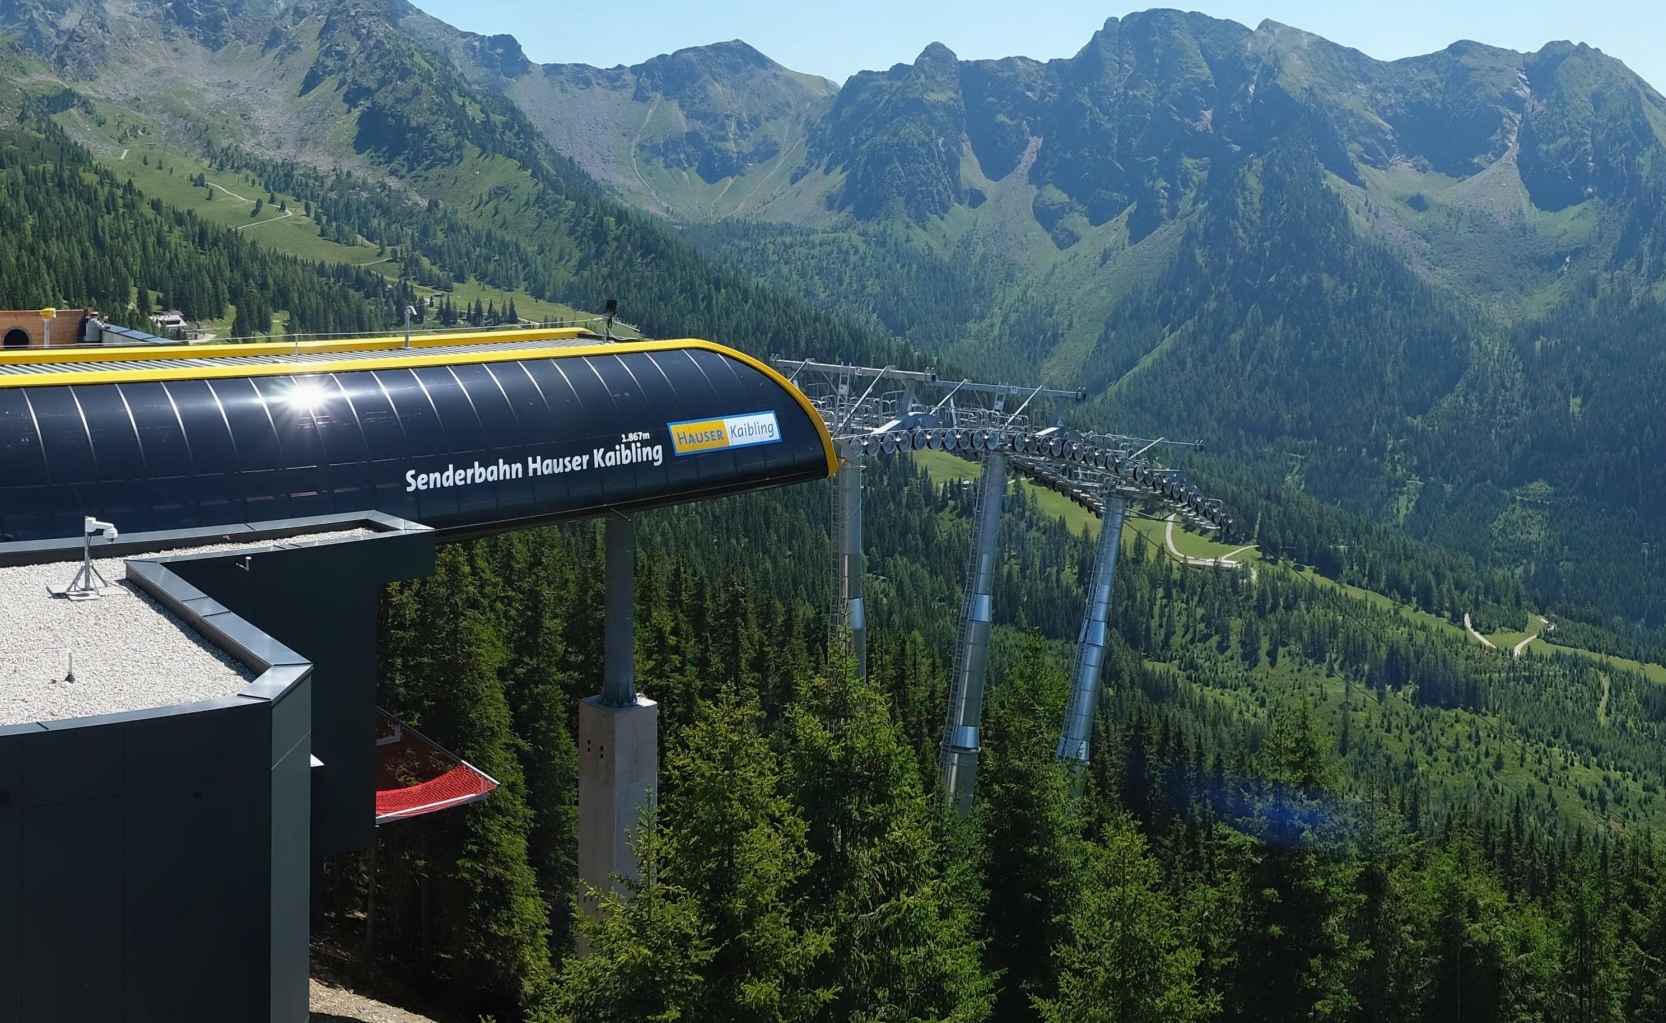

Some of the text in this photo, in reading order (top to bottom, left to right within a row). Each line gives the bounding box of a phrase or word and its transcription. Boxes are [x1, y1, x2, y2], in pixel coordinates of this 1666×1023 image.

[621, 431, 650, 443] 1.867m
[676, 419, 775, 445] HAUSER Kaibling
[405, 441, 663, 492] Senderbahn Hauser Kaibling
